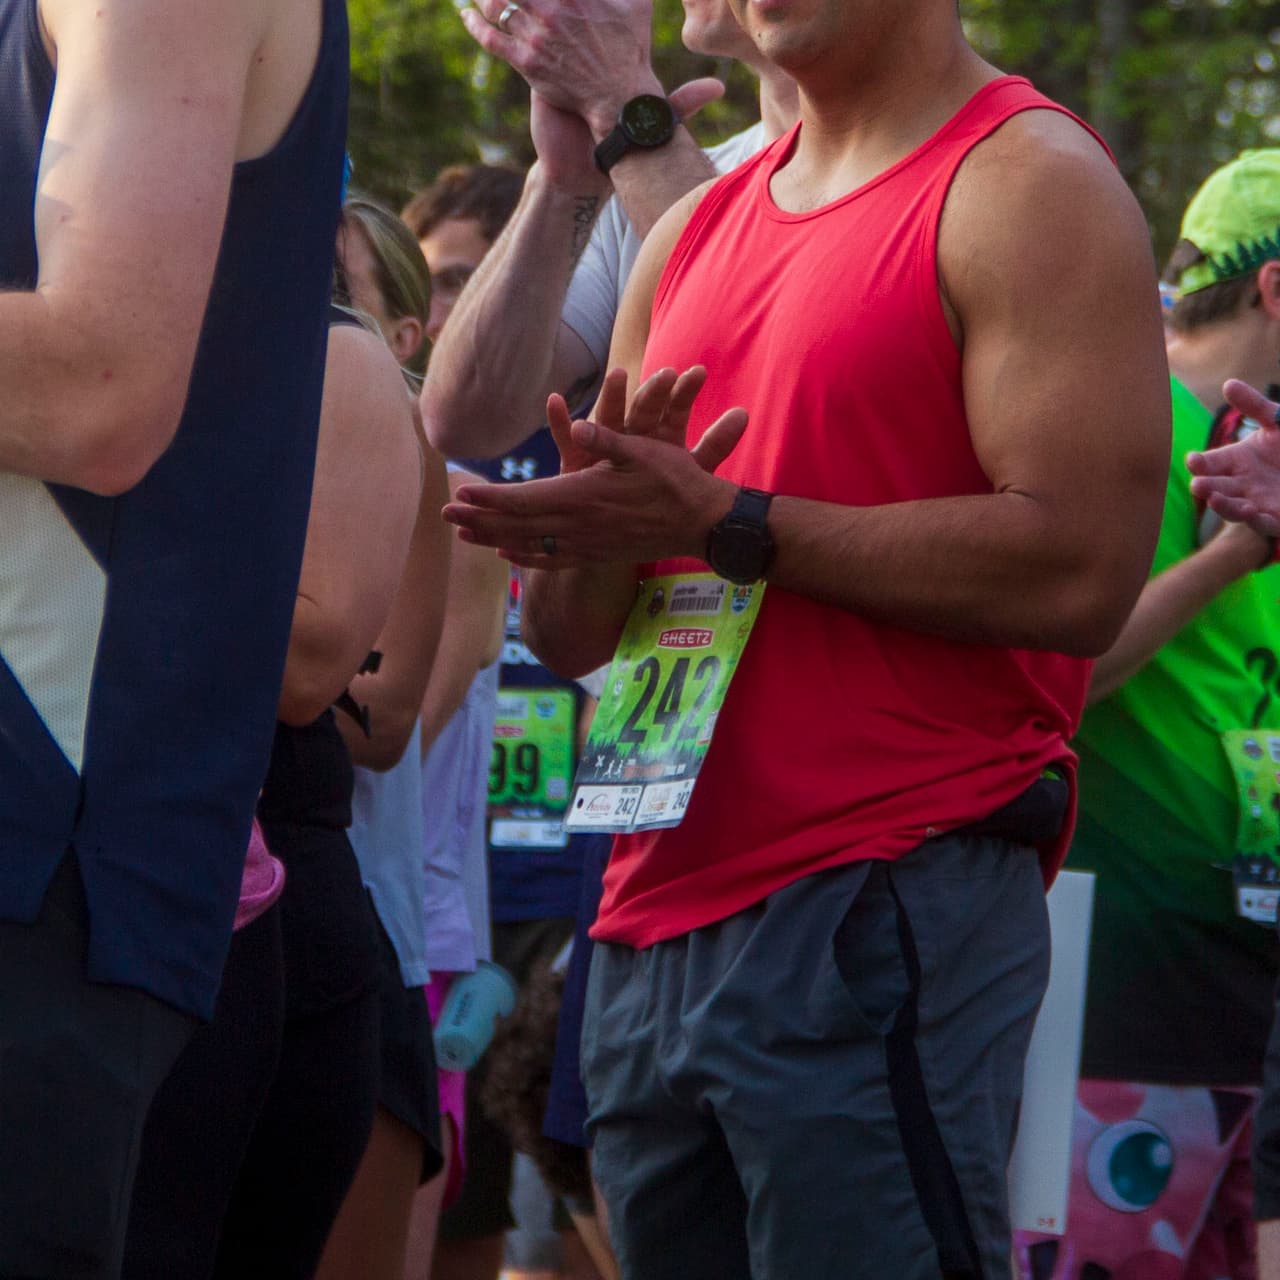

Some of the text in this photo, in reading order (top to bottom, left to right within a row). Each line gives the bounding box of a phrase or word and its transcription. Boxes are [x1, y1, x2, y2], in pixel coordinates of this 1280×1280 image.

[660, 632, 710, 645] SHEETZ
[617, 656, 721, 743] 242
[615, 797, 636, 815] 242
